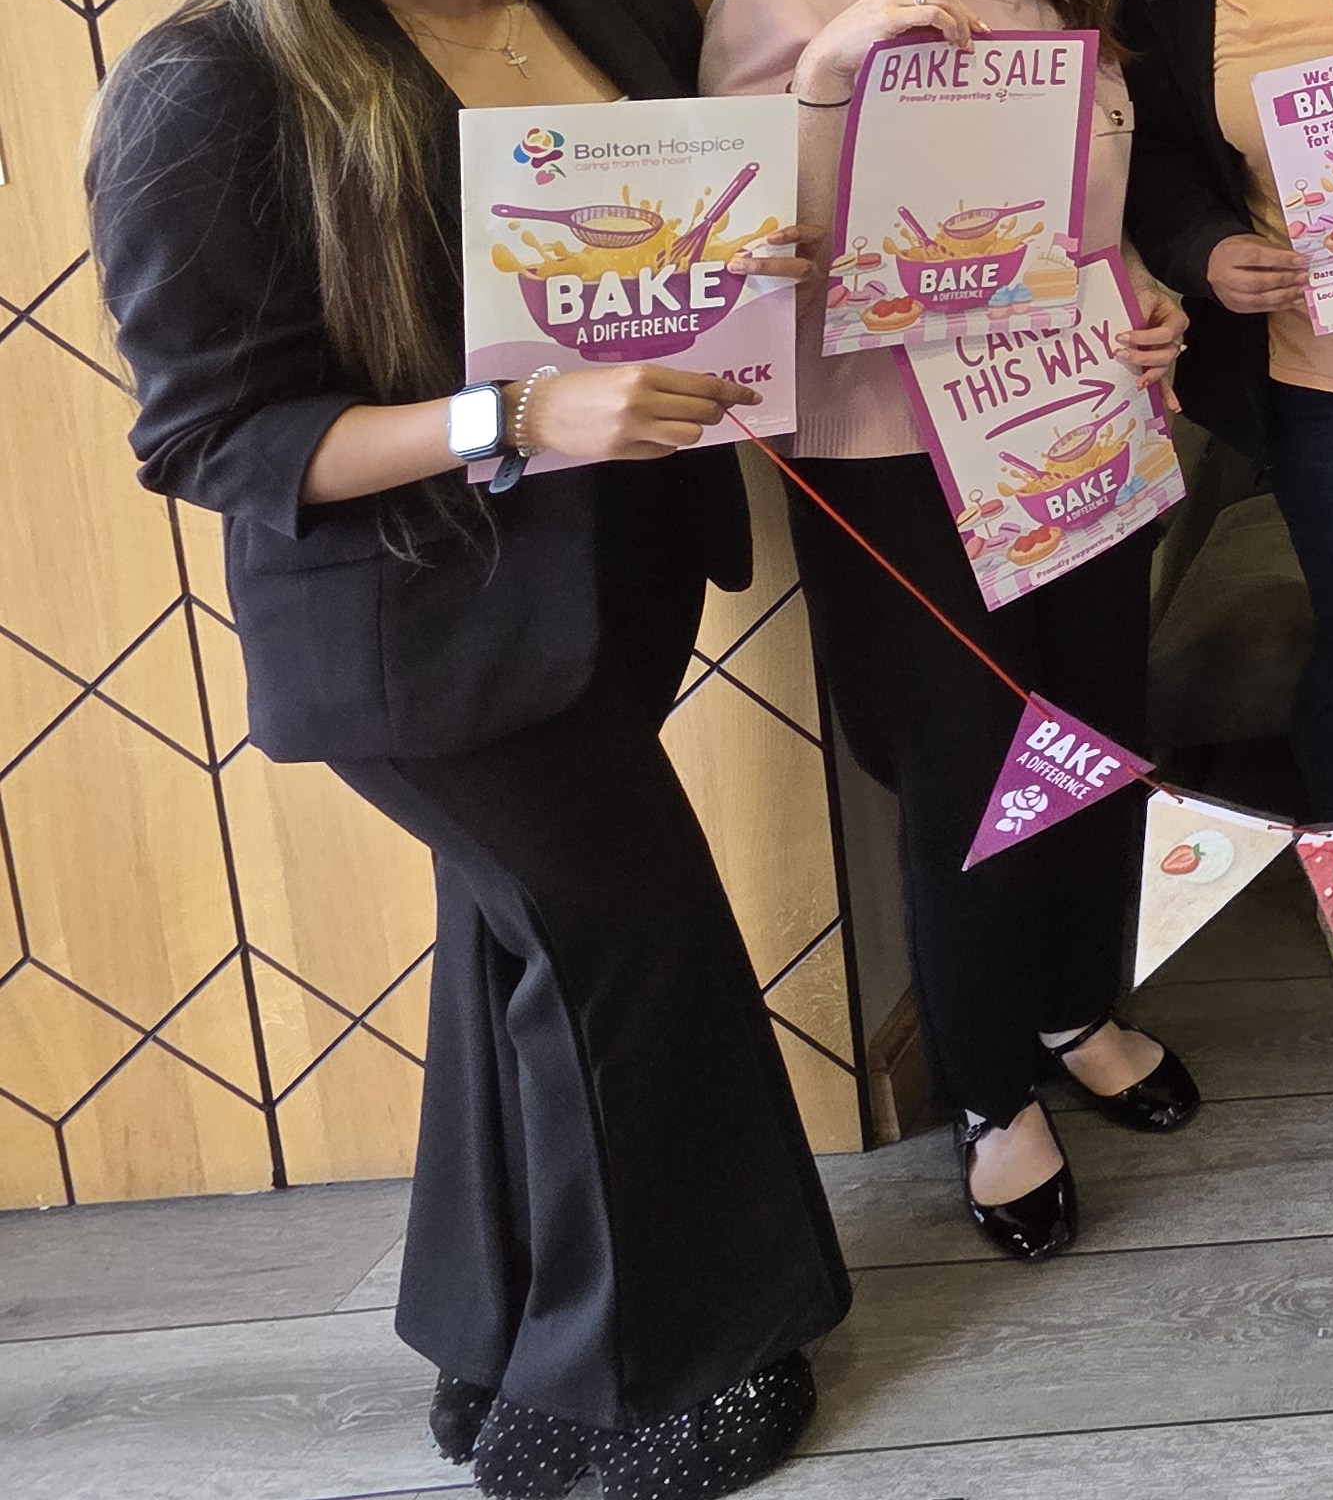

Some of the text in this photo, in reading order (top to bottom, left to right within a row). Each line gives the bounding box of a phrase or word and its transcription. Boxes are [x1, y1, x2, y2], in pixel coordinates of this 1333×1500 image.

[880, 47, 1068, 92] BAKE SALE
[574, 136, 745, 160] Bolton Hospice
[1303, 123, 1319, 137] to
[1306, 133, 1331, 149] for
[545, 260, 727, 326] BAKE
[919, 263, 1000, 295] BAKE
[576, 313, 700, 345] A DIFFERENCE
[956, 328, 1061, 367] CA
[703, 363, 773, 384] ACK
[1038, 320, 1117, 385] WAY
[943, 358, 1031, 421] THIS
[1045, 468, 1118, 520] BAKE
[1025, 719, 1121, 788] BAKE
[1016, 751, 1092, 800] A DIFFERENCE
